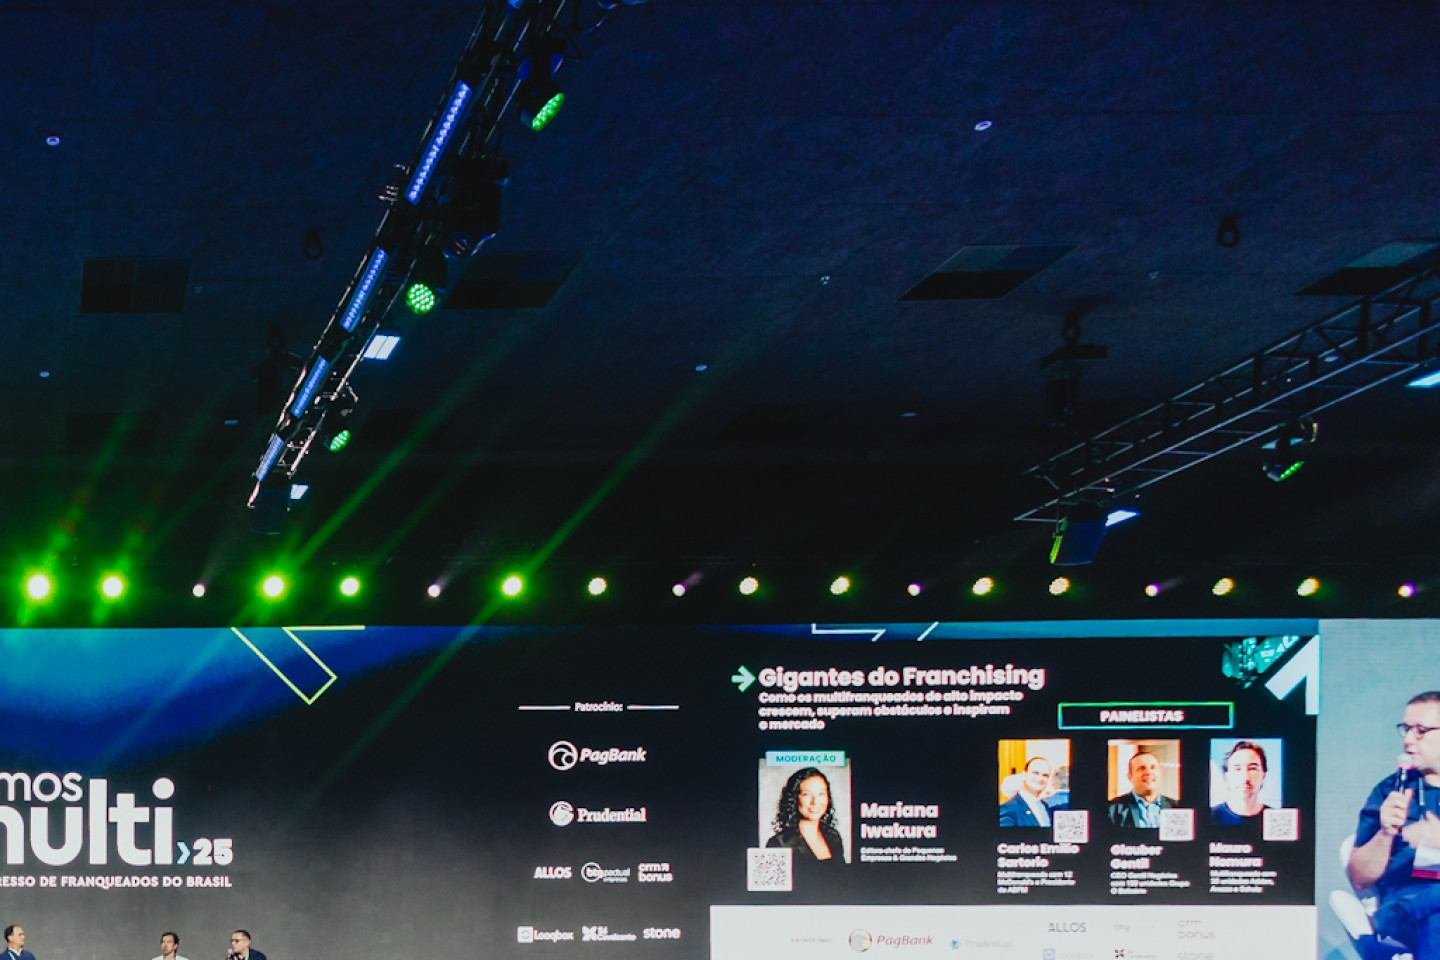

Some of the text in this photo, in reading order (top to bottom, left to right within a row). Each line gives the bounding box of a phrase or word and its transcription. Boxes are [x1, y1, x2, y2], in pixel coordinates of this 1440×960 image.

[758, 664, 1045, 692] Gigantes do Franchising
[759, 691, 796, 704] Como
[813, 690, 924, 705] multifranqueados
[943, 690, 968, 703] alto
[969, 690, 1024, 704] impacto
[575, 702, 623, 712] Patrocínio:
[817, 706, 872, 720] superam
[953, 703, 1010, 718] inspiram
[1099, 710, 1184, 723] PAINELISTAS
[769, 719, 825, 730] mercado
[579, 747, 647, 765] PagBank
[776, 752, 836, 764] MODERAÇÃO
[577, 808, 647, 823] Prudential
[860, 801, 939, 819] Mariana
[860, 823, 937, 839] Iwakura
[193, 838, 234, 866] 25
[997, 843, 1039, 854] Carlos
[1110, 844, 1163, 856] Glauber
[1209, 843, 1253, 853] Mauro
[1209, 856, 1263, 867] Nomura
[534, 866, 573, 879] ALLOS
[638, 872, 673, 882] bonus
[40, 875, 57, 888] DE
[60, 875, 159, 890] FRANQUEADOS
[163, 875, 183, 888] DO
[186, 875, 232, 888] BRASIL
[643, 926, 681, 939] stone
[1048, 921, 1088, 933] ALLOS
[876, 934, 933, 948] PagBank
